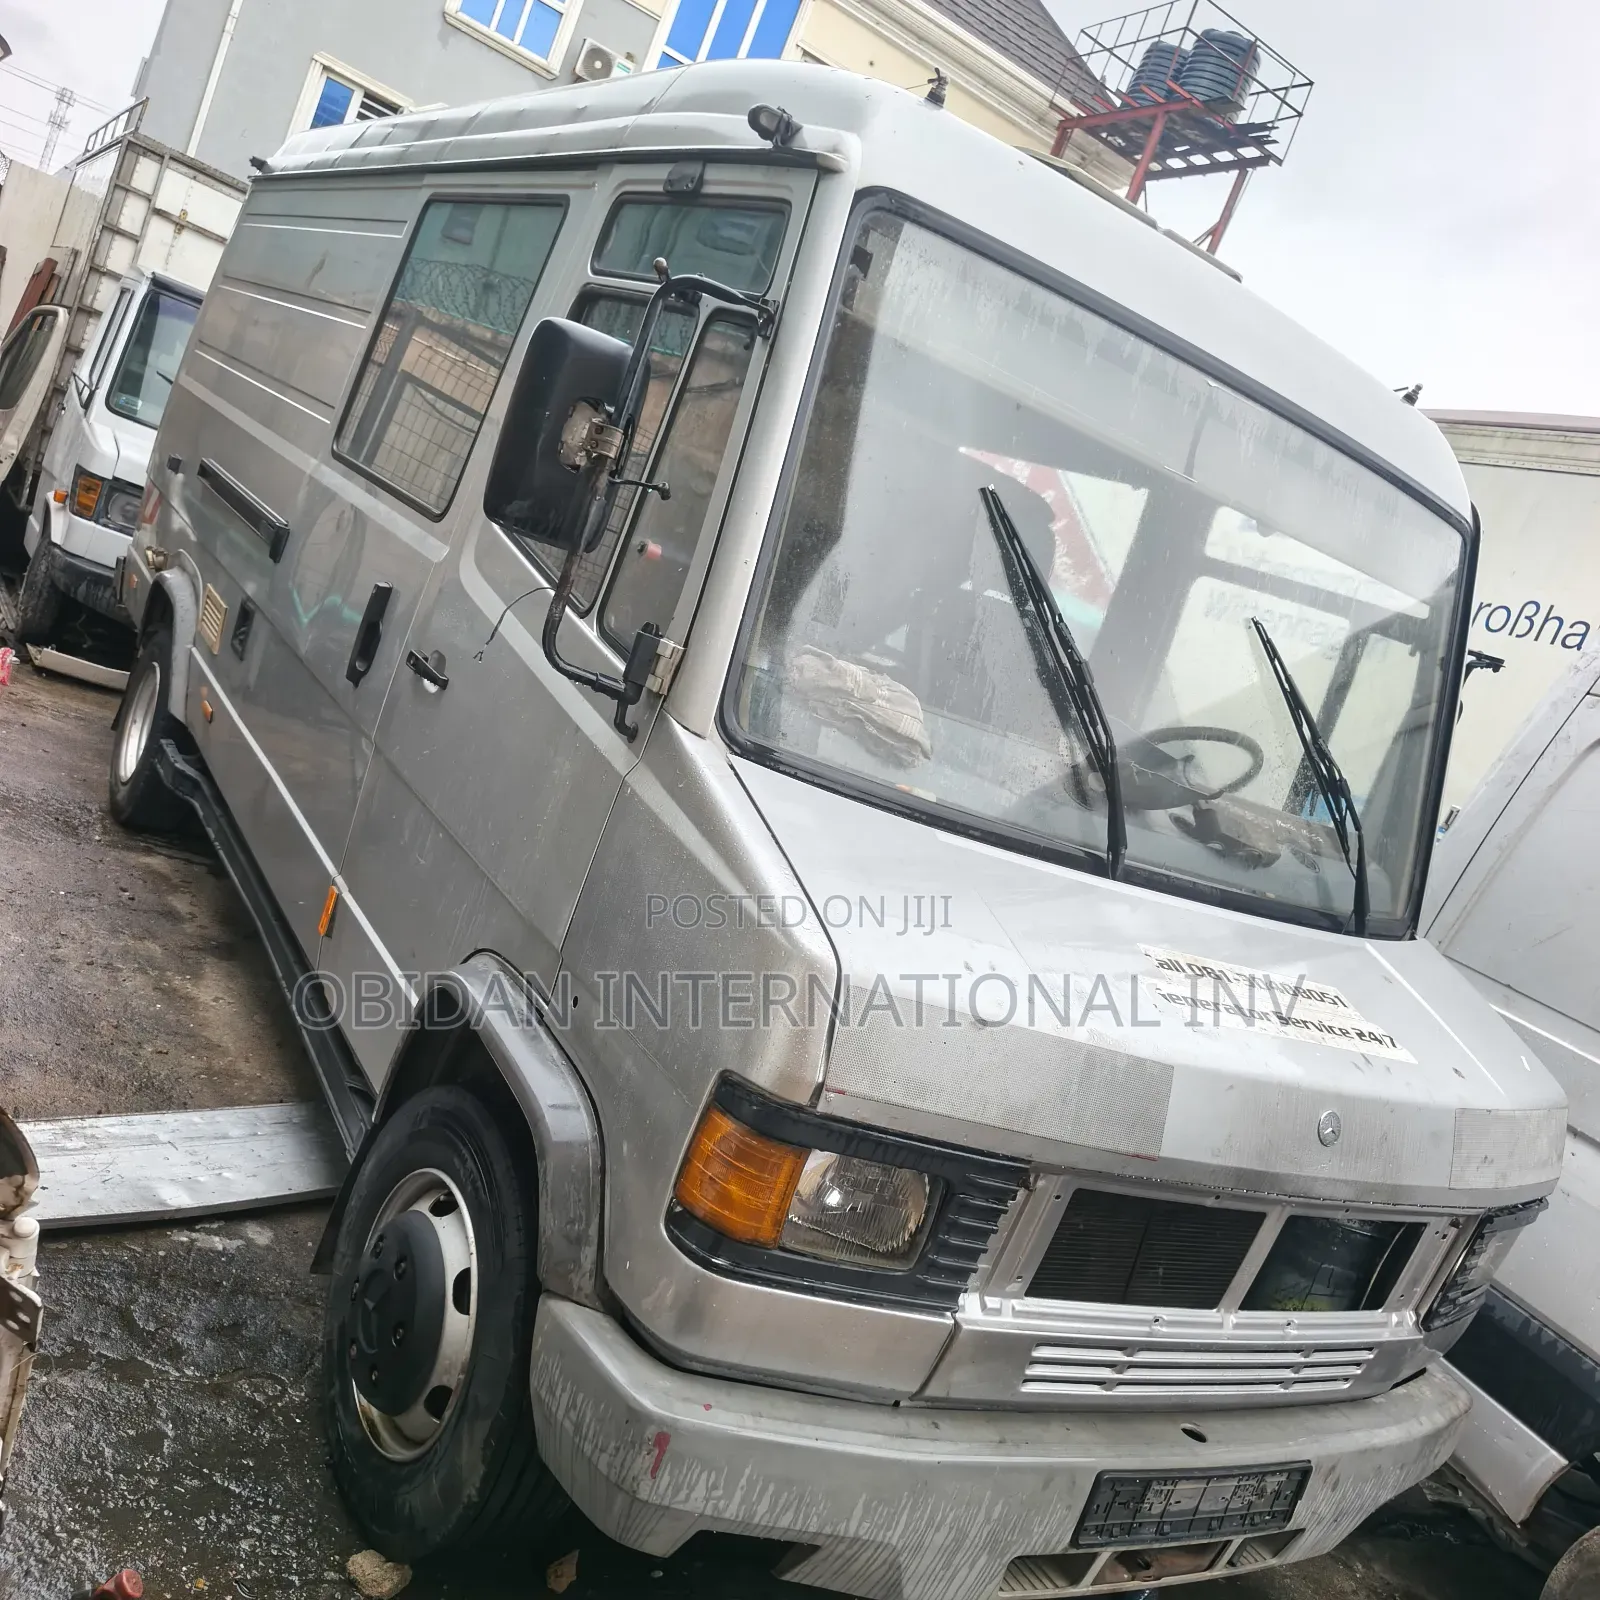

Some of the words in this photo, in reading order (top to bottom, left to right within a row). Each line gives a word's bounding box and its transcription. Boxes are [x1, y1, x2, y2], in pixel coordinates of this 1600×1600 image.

[1471, 600, 1600, 651] roßha
[1144, 953, 1188, 974] all
[1272, 1010, 1355, 1039] Service
